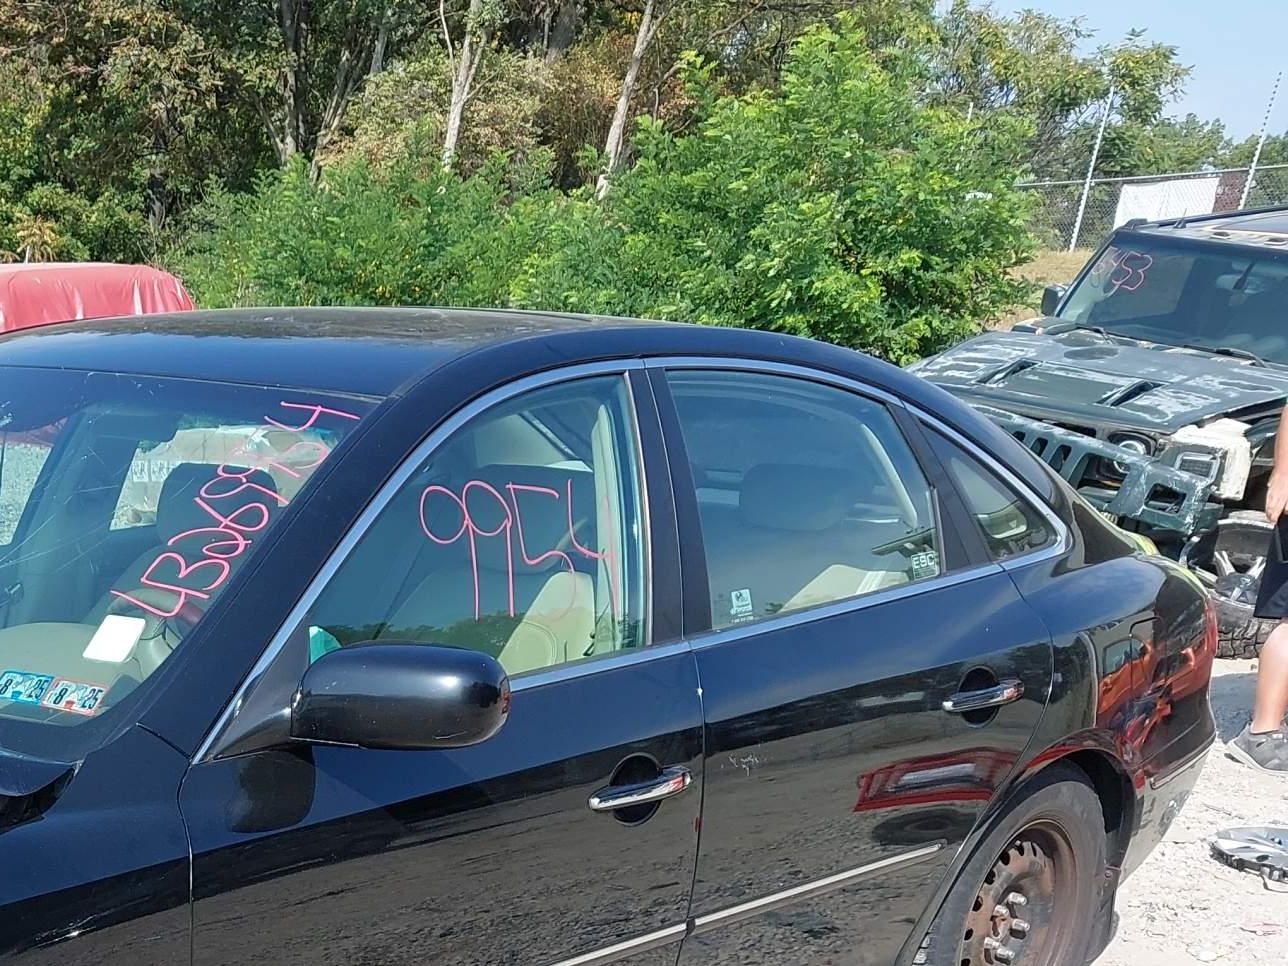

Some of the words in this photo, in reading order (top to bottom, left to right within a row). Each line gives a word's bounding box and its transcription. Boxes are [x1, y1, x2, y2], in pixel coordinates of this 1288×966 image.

[418, 478, 620, 622] 9954
[27, 678, 50, 699] 25
[52, 687, 69, 705] 8
[81, 687, 104, 710] 25
